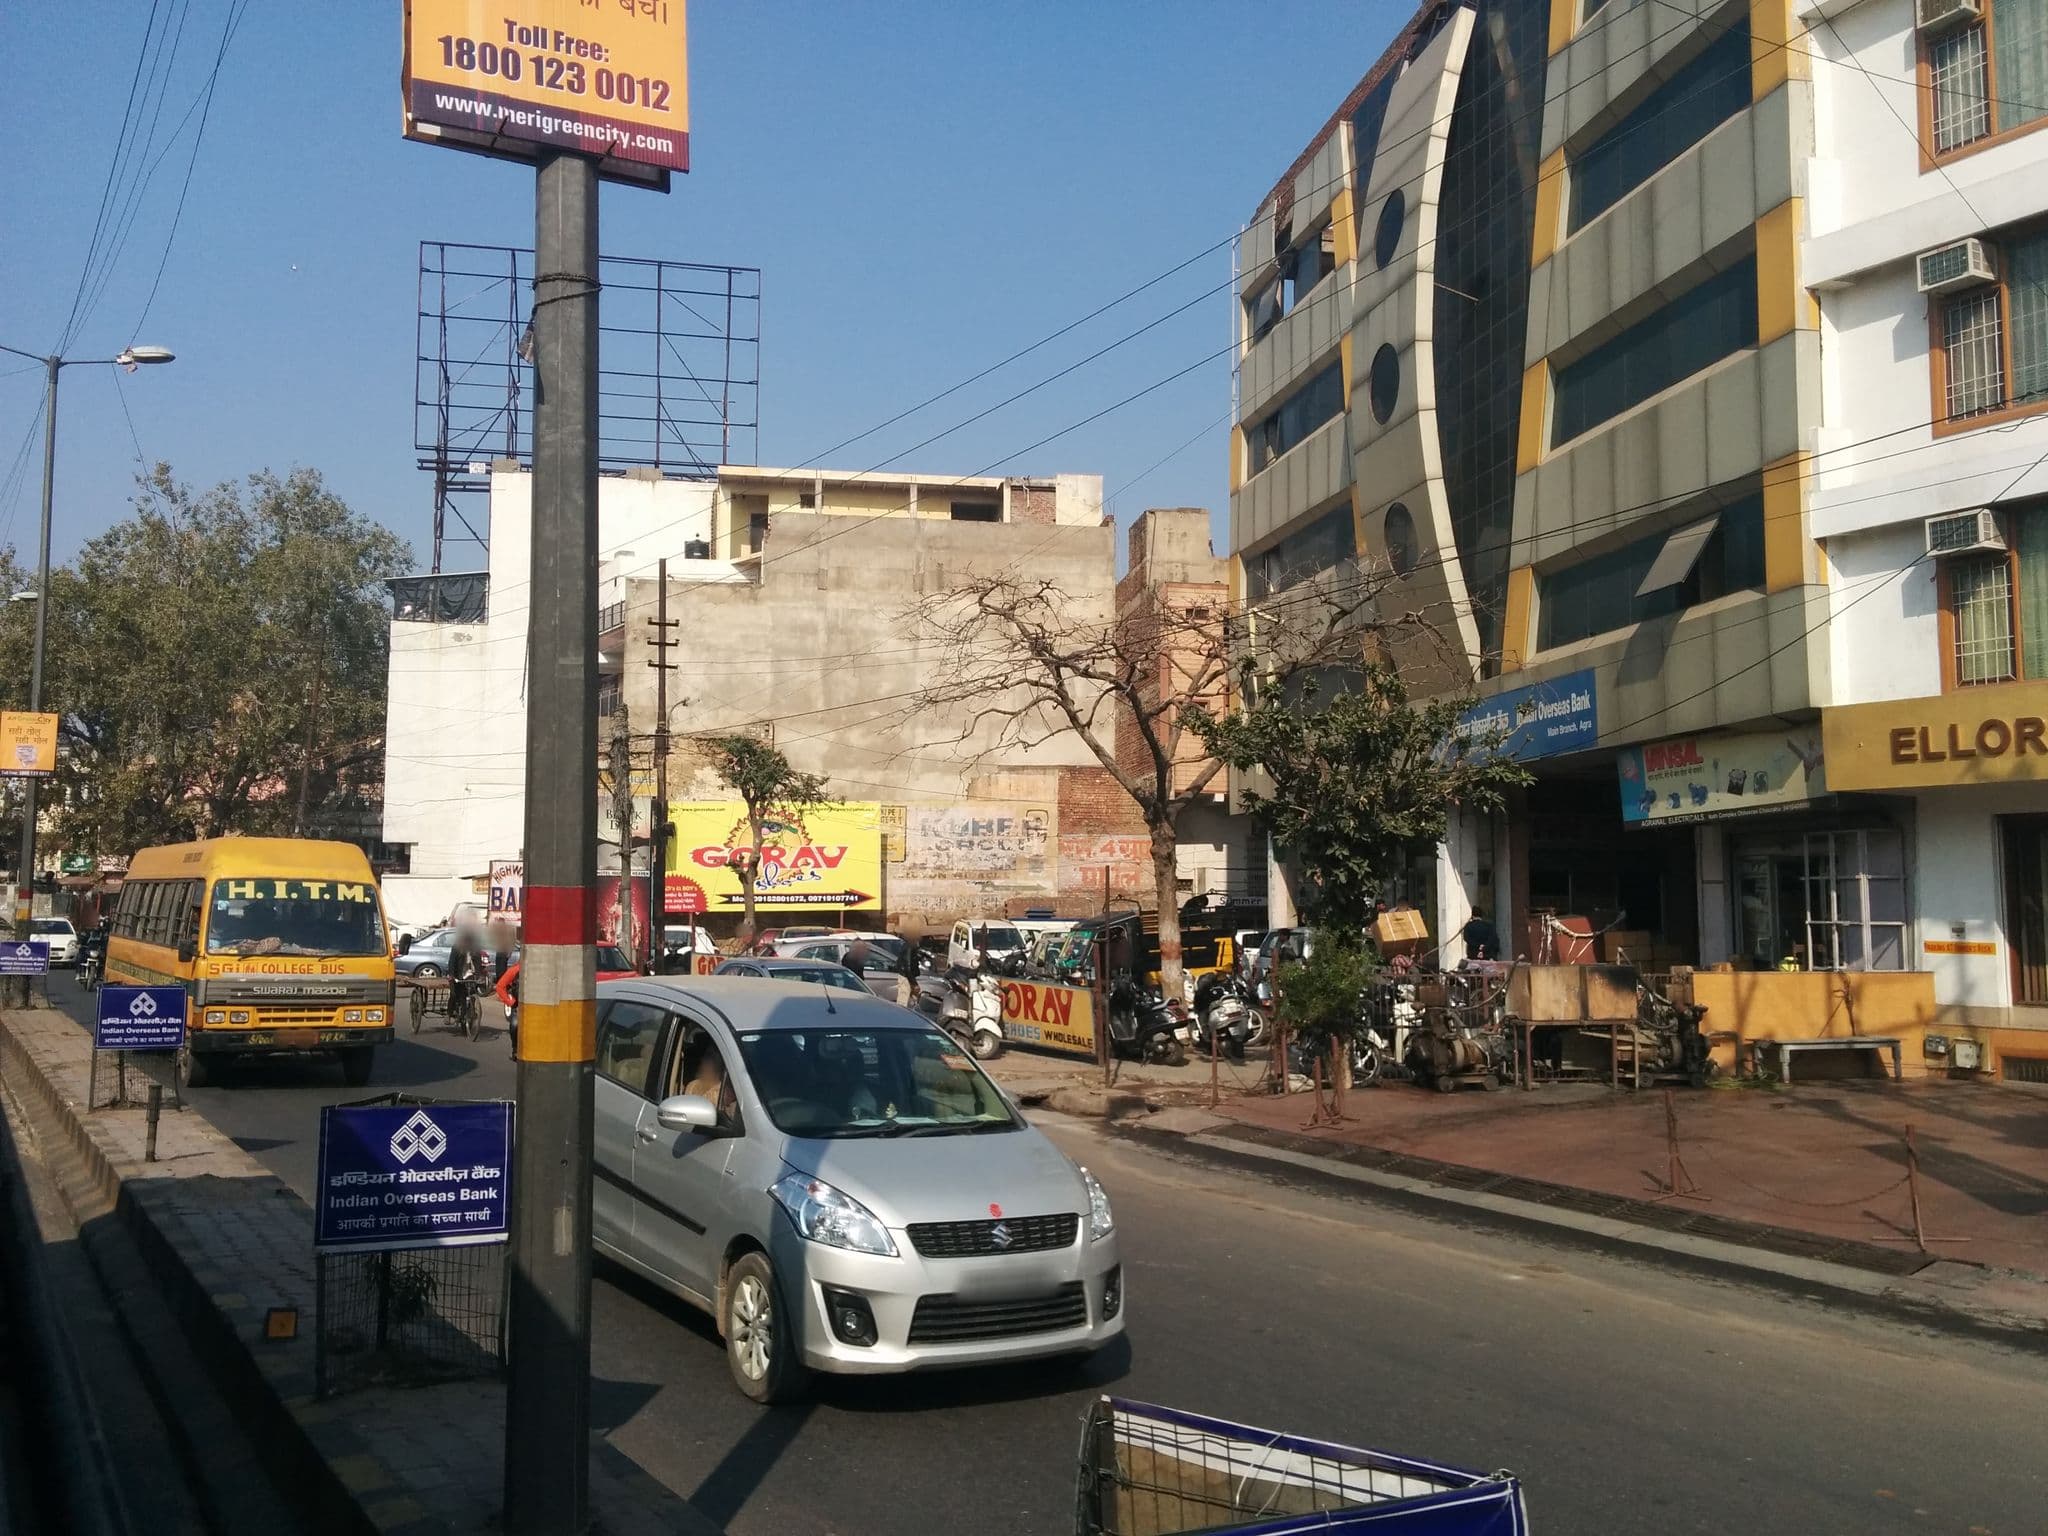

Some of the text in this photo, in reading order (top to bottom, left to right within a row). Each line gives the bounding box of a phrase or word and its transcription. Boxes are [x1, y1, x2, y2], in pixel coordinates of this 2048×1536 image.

[503, 18, 609, 63] Toll Free:
[437, 35, 671, 112] 1800 123 0012
[435, 93, 674, 154] www.merigreencity.com
[1538, 698, 1570, 720] Overseas
[1571, 689, 1592, 712] Bank
[1579, 719, 1593, 731] Agra
[1889, 717, 2048, 765] ELLOR
[690, 846, 848, 869] GORAV
[491, 887, 523, 911] BA
[261, 963, 314, 975] COLLEGE
[320, 963, 345, 975] BUS
[1001, 982, 1073, 1026] ORAV
[1044, 1029, 1093, 1049] WHOLESALE
[330, 1187, 498, 1208] Indian Overseas Bank
